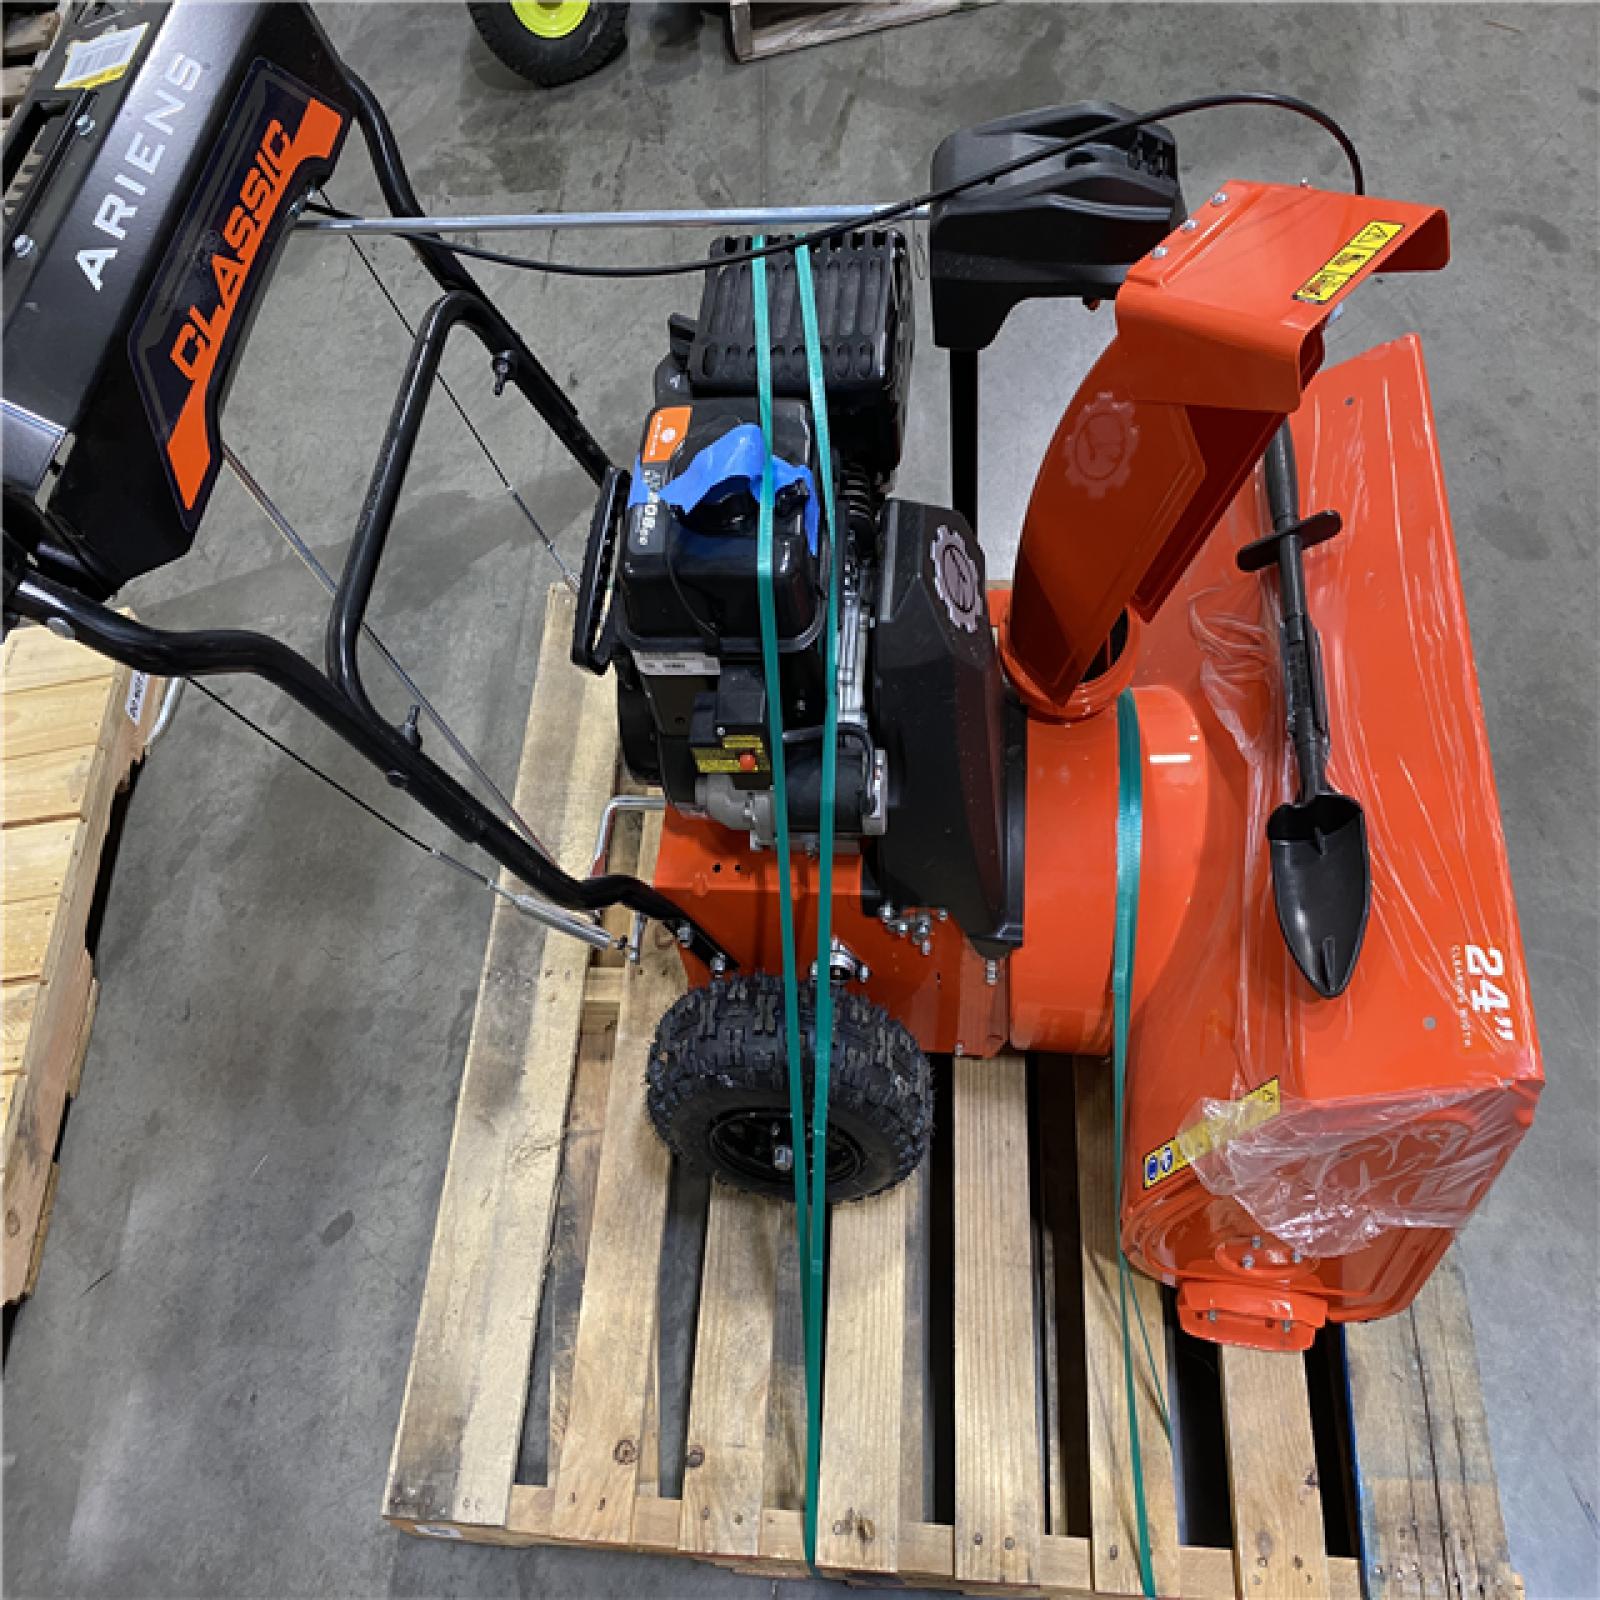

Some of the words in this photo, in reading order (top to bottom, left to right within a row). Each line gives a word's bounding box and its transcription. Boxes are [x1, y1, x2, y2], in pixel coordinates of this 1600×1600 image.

[76, 53, 202, 291] ARIENS
[169, 118, 293, 381] CLASSIC
[1465, 944, 1515, 1041] 24"
